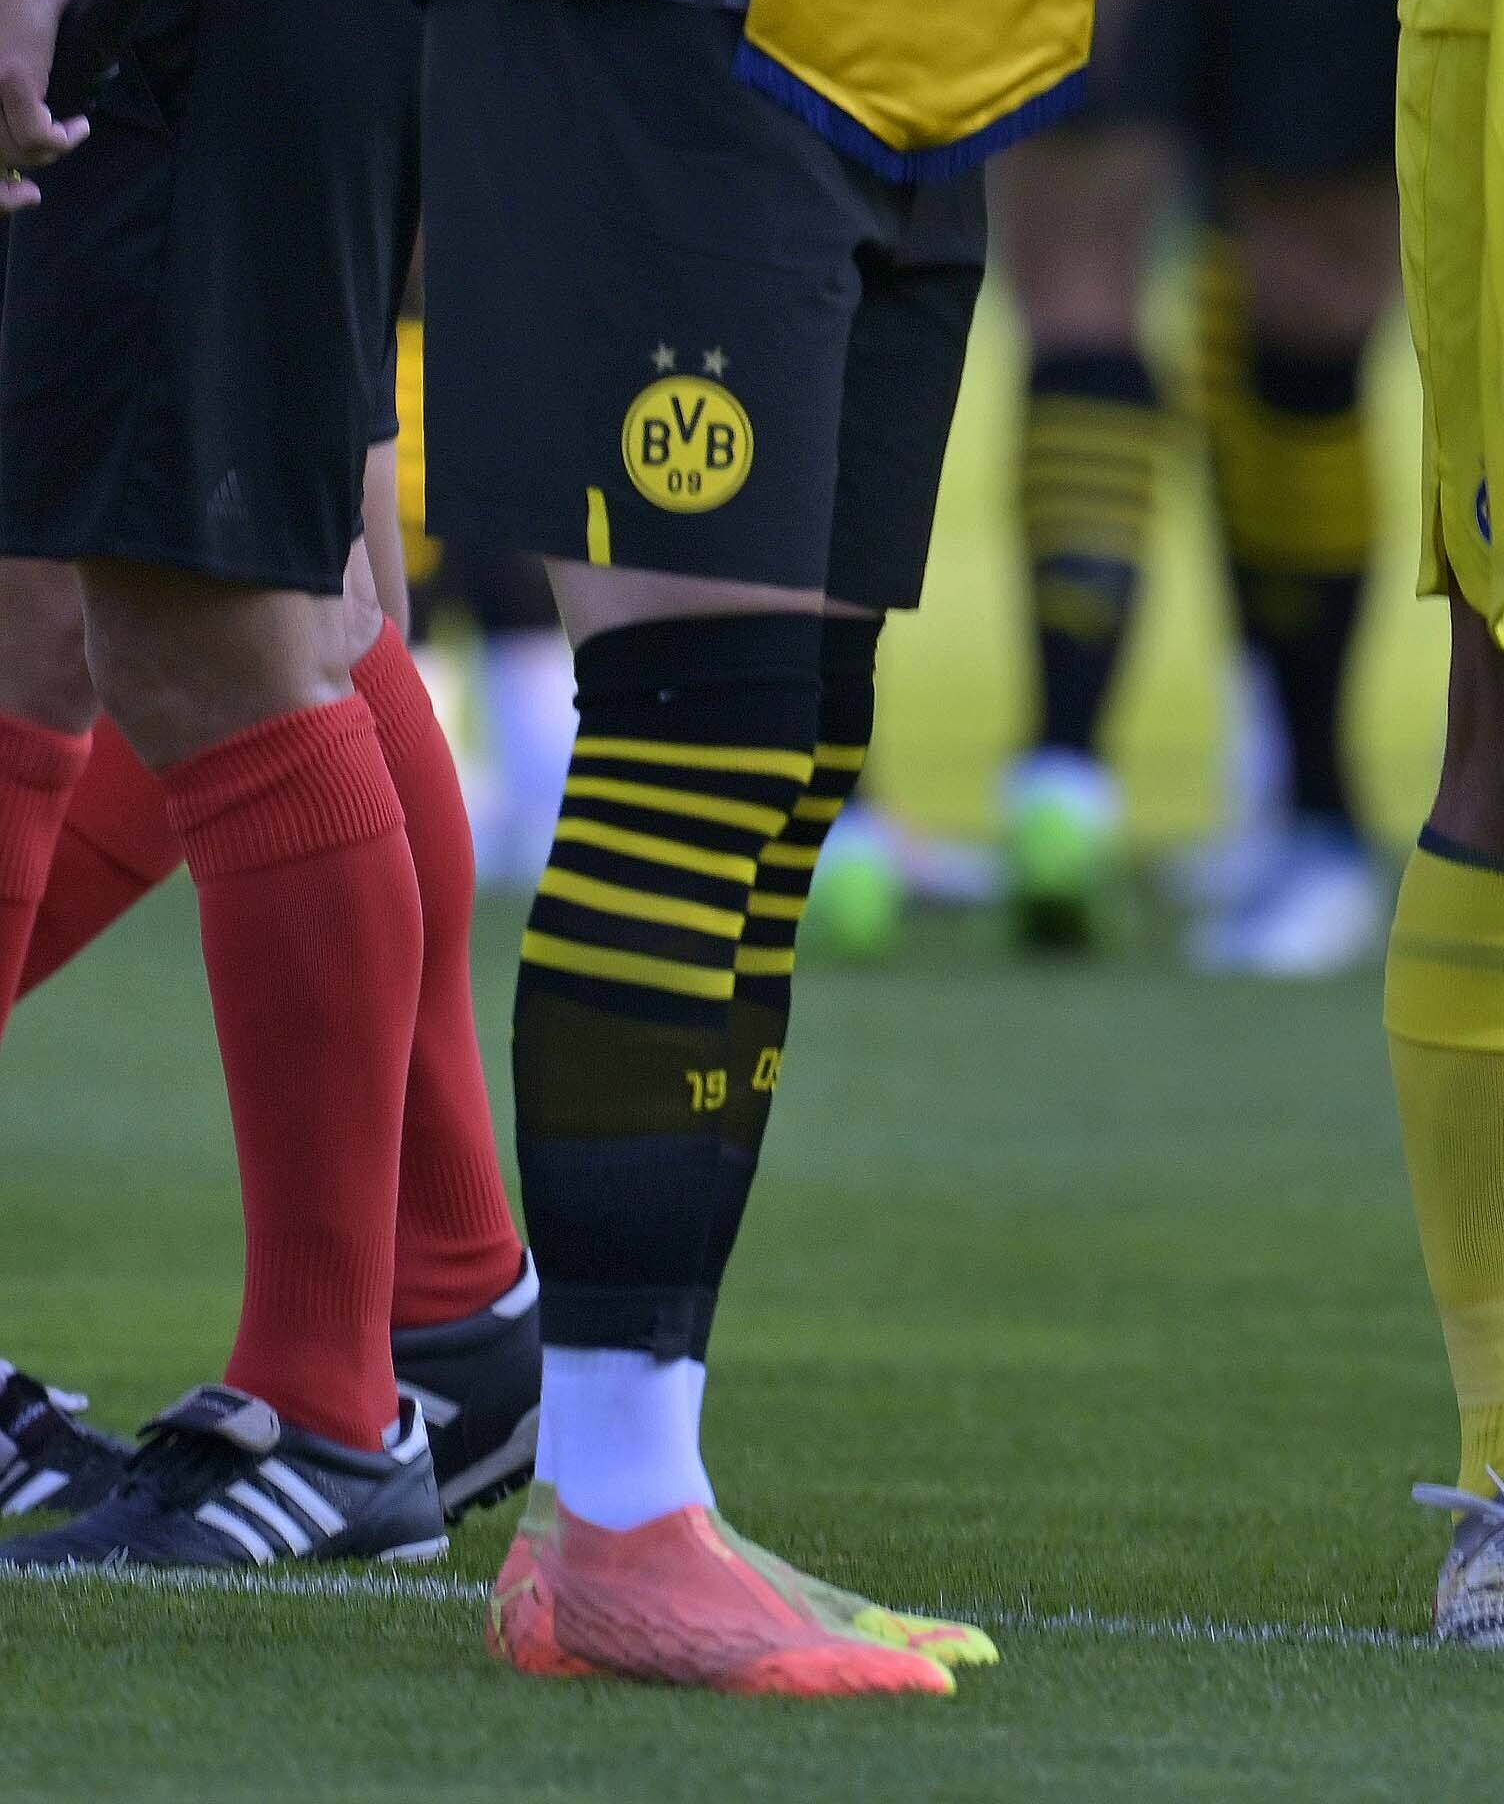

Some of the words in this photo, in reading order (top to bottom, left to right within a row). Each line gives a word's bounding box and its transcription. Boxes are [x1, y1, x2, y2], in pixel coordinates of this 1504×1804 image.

[642, 395, 735, 470] BVB
[668, 469, 702, 495] 09
[686, 1068, 728, 1112] 19
